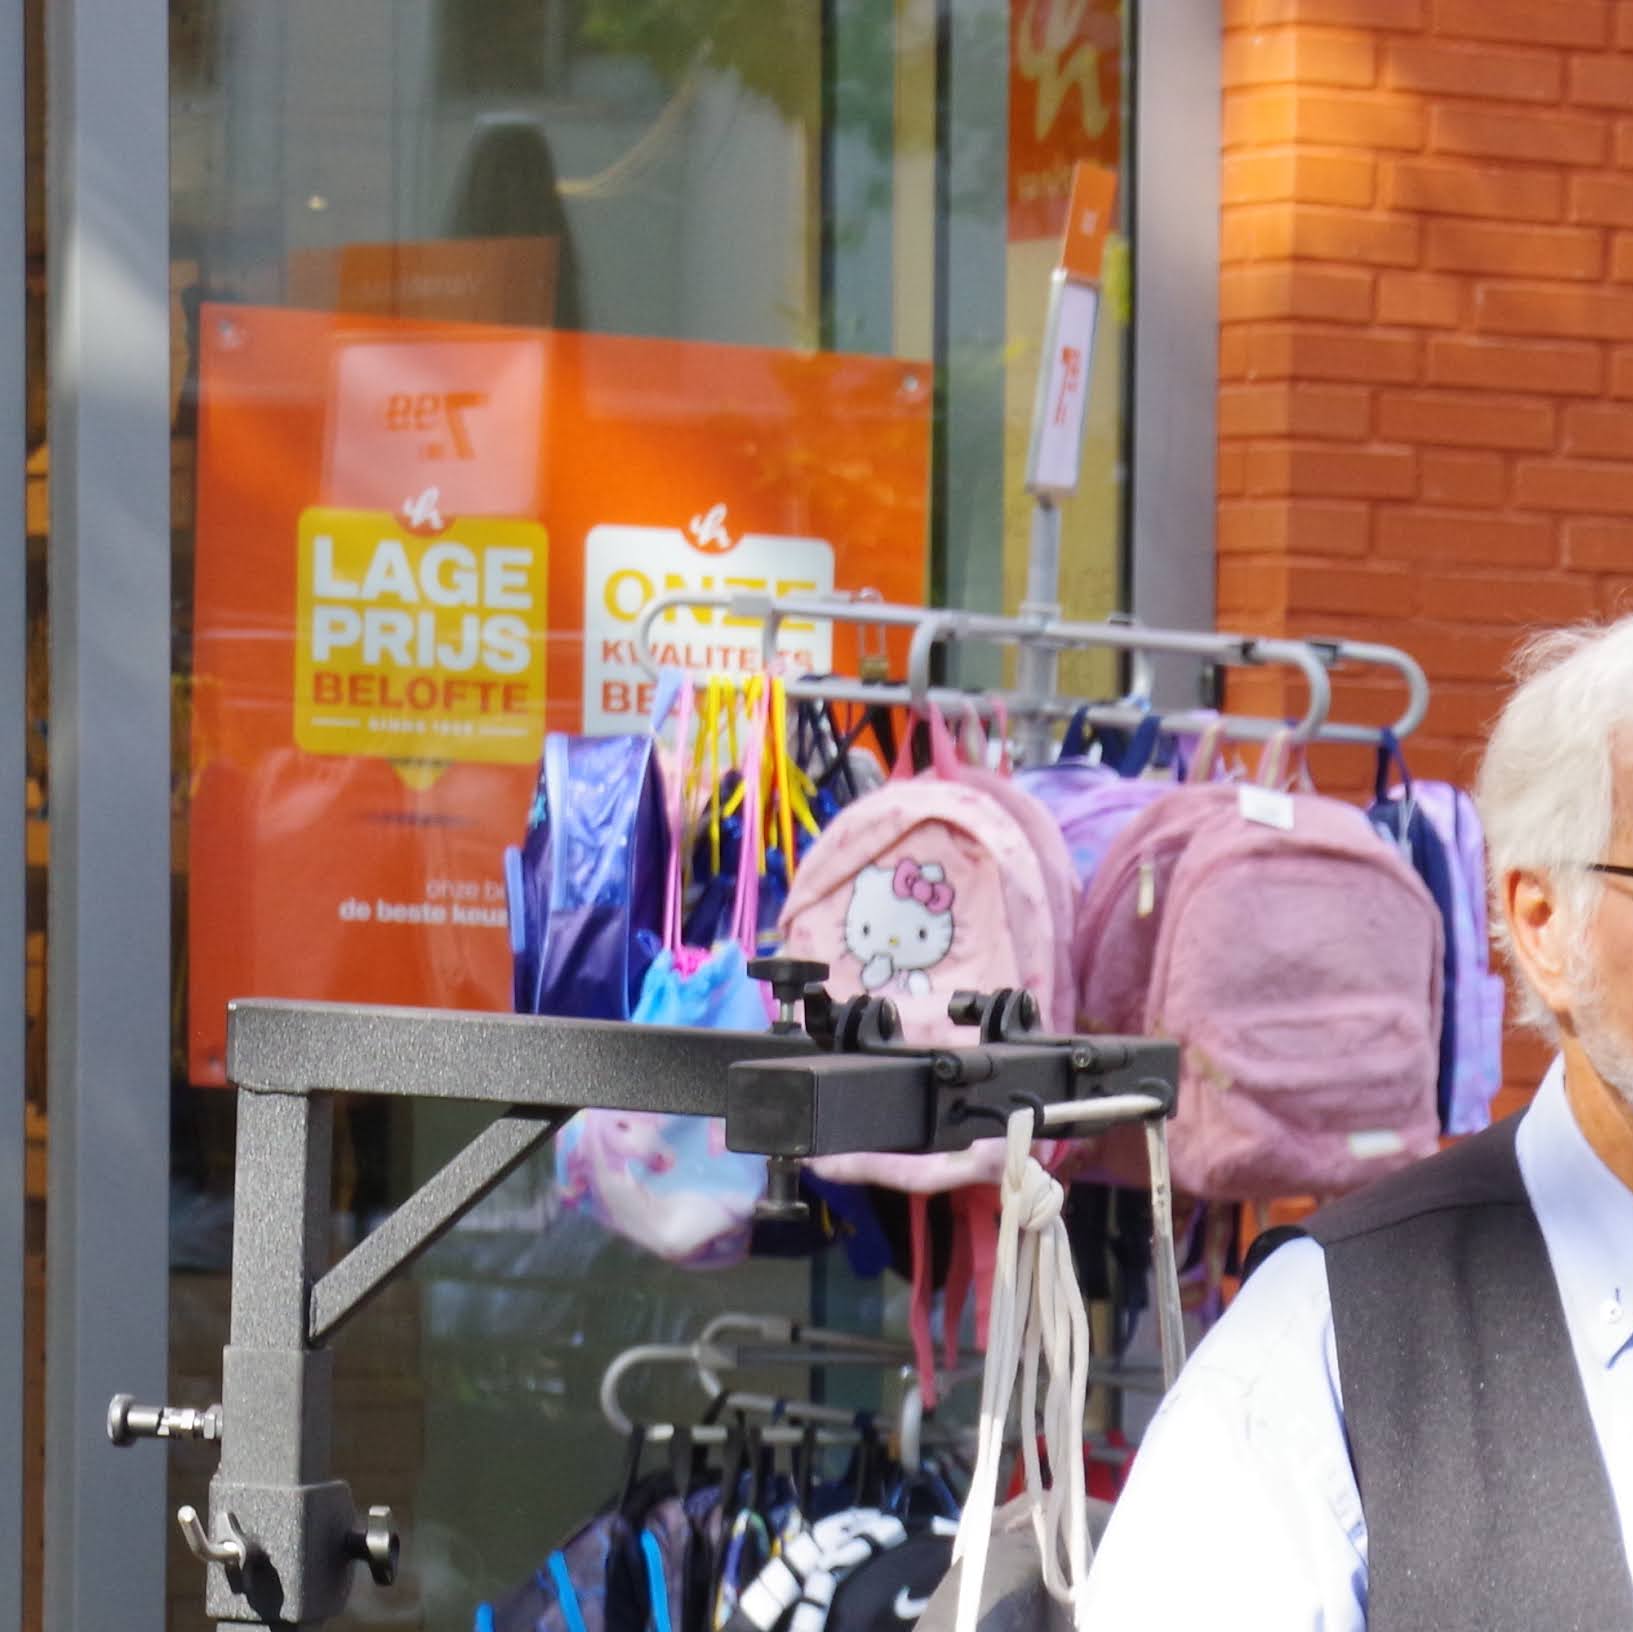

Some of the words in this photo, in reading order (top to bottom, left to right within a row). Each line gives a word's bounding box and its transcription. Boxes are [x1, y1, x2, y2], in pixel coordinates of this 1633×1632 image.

[312, 535, 534, 610] LAGE
[311, 604, 532, 675] PRIJS
[312, 671, 530, 715] BELOFTE
[338, 897, 372, 921] de
[376, 899, 446, 924] beste
